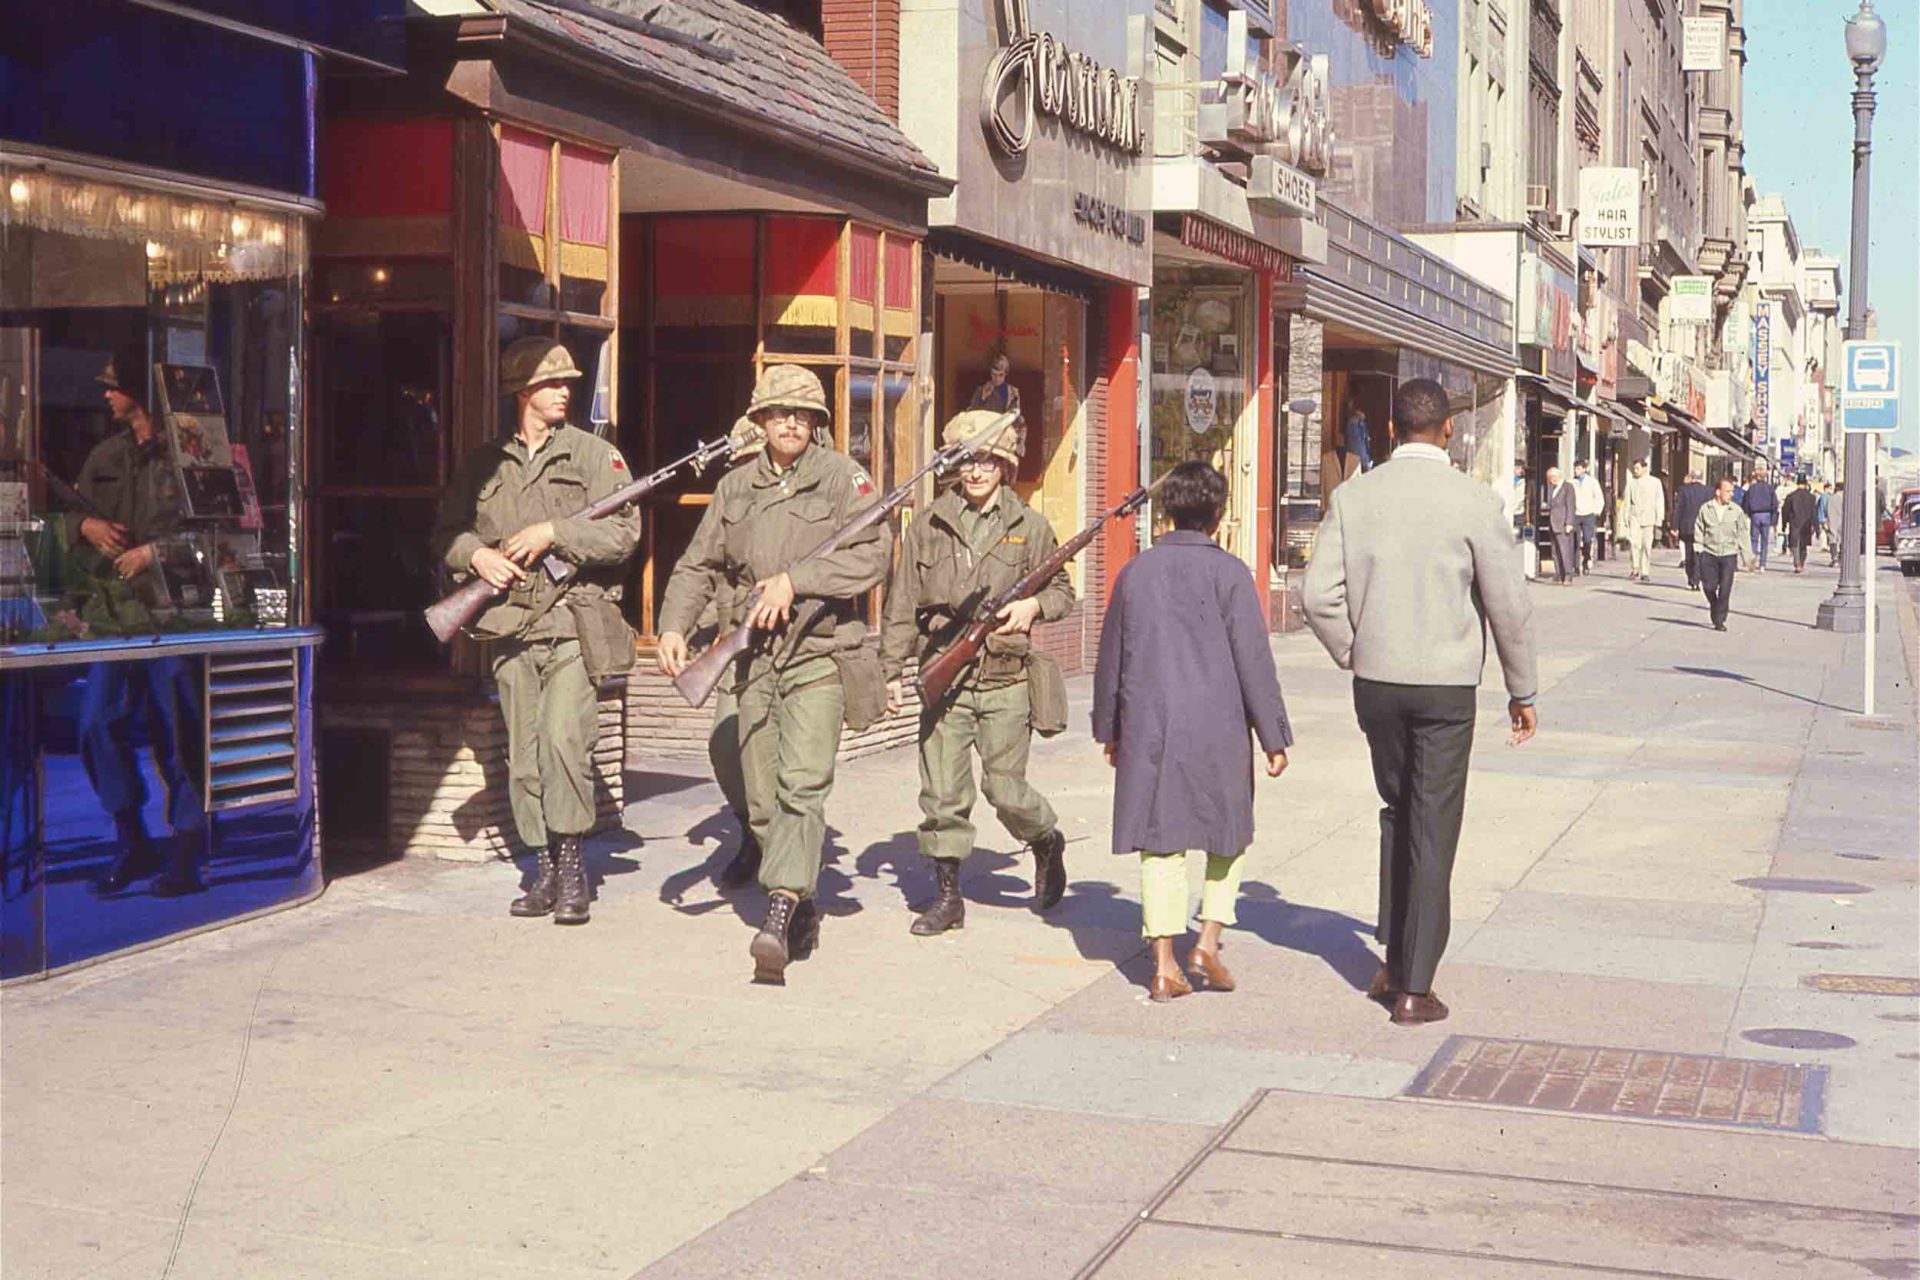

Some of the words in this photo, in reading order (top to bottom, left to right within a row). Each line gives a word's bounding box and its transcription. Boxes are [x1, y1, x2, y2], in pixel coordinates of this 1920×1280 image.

[1277, 167, 1311, 208] SHOES
[1584, 226, 1633, 239] STYLIST
[1597, 209, 1628, 221] HAIR
[1757, 304, 1770, 378] MASSEY
[1756, 382, 1769, 442] SHOES
